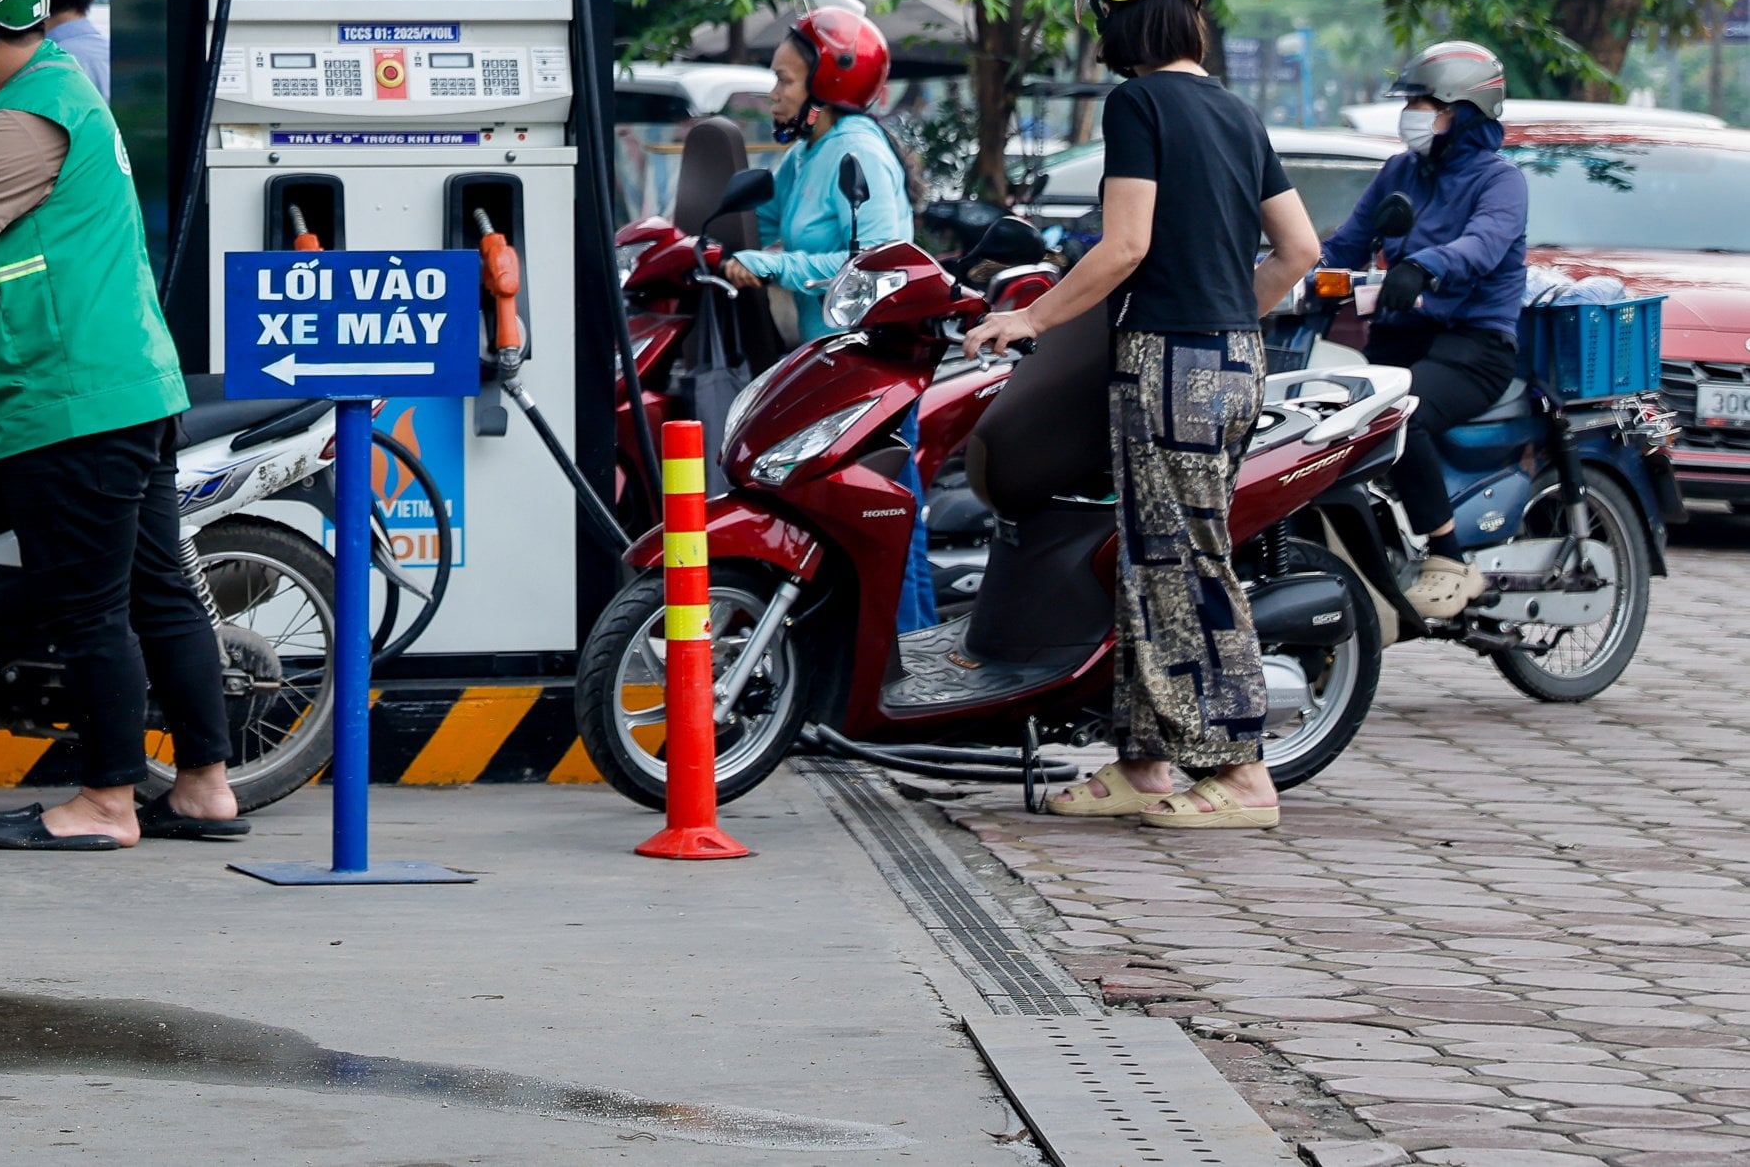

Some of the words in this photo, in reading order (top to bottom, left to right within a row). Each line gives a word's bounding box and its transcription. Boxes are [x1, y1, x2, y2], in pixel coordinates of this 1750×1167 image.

[344, 27, 372, 40] TCCS
[394, 27, 454, 40] 2025/PVOIL
[288, 134, 313, 144] TRẢ
[316, 134, 332, 144] VỀ
[362, 134, 404, 144] TRƯỚC
[408, 135, 429, 144] KHI
[433, 135, 462, 144] BƠM
[258, 258, 332, 300] LỐI
[350, 255, 446, 300] VÀO
[256, 313, 319, 345] XE
[338, 306, 448, 344] MÁY
[1278, 446, 1354, 486] VISION
[862, 508, 907, 518] HONDA
